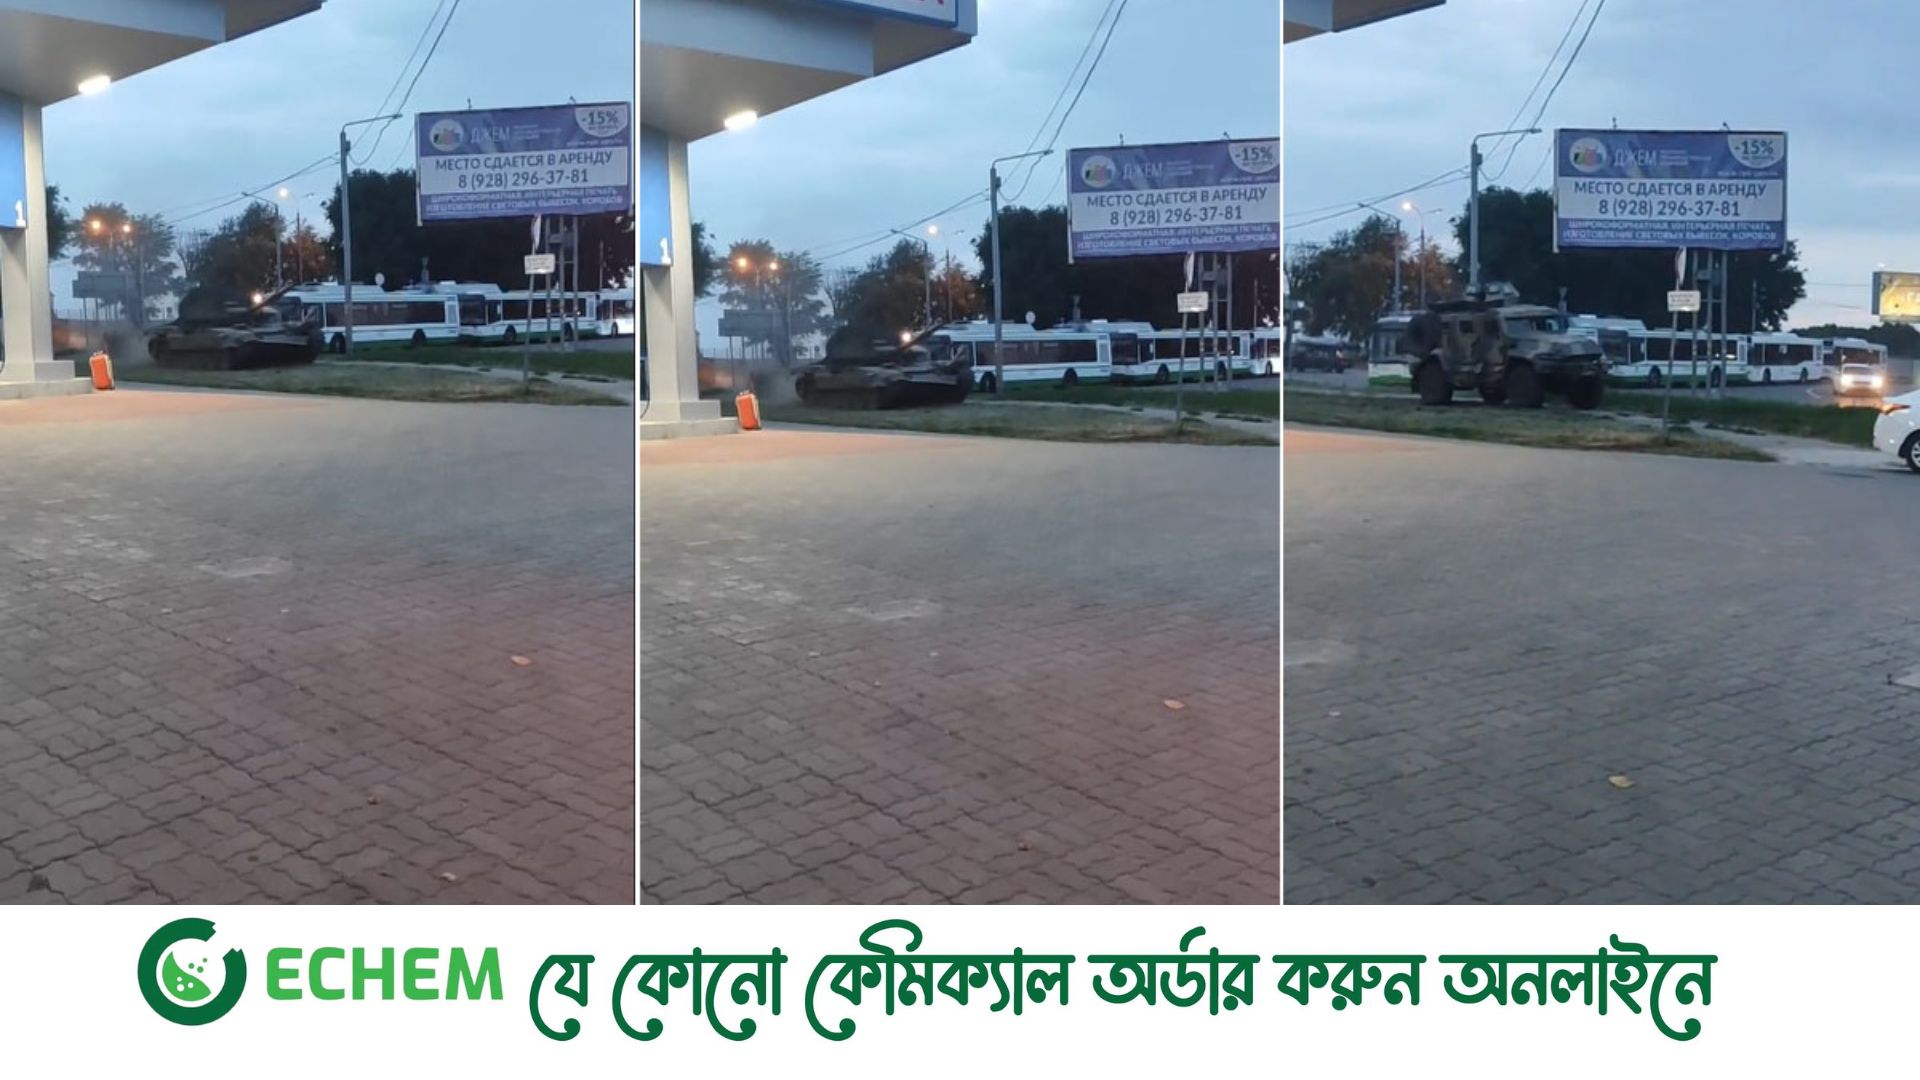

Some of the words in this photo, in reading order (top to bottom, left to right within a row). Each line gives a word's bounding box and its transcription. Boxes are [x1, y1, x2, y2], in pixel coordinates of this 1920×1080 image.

[581, 111, 619, 125] -15%
[471, 127, 510, 143] ДЖЕМ
[1235, 147, 1273, 161] -15%
[1735, 140, 1774, 155] -15%
[435, 158, 480, 171] МЕСТО
[484, 155, 543, 169] СДАЕТСЯ
[548, 154, 556, 165] В
[559, 151, 612, 164] АРЕНДУ
[1613, 150, 1657, 167] ДЖЕМ
[1122, 162, 1163, 179] ДЖЕМ
[458, 174, 467, 188] 8
[471, 172, 508, 191] (928)
[512, 169, 588, 186] 296-37-81
[1087, 194, 1132, 207] МЕСТО
[1136, 191, 1197, 206] СДАЕТСЯ
[1201, 191, 1209, 202] В
[1213, 187, 1267, 201] АРЕНДУ
[1574, 181, 1623, 195] МЕСТО
[1627, 182, 1692, 197] СДАЕТСЯ
[1697, 183, 1705, 195] В
[1708, 183, 1767, 198] АРЕНДУ
[15, 200, 26, 227] 1
[1110, 211, 1119, 225] 8
[1124, 208, 1160, 227] (928)
[1165, 205, 1242, 223] 296-37-81
[1599, 199, 1608, 214] 8
[1613, 199, 1653, 218] (928)
[1657, 201, 1740, 217] 296-37-81
[660, 238, 671, 264] 1
